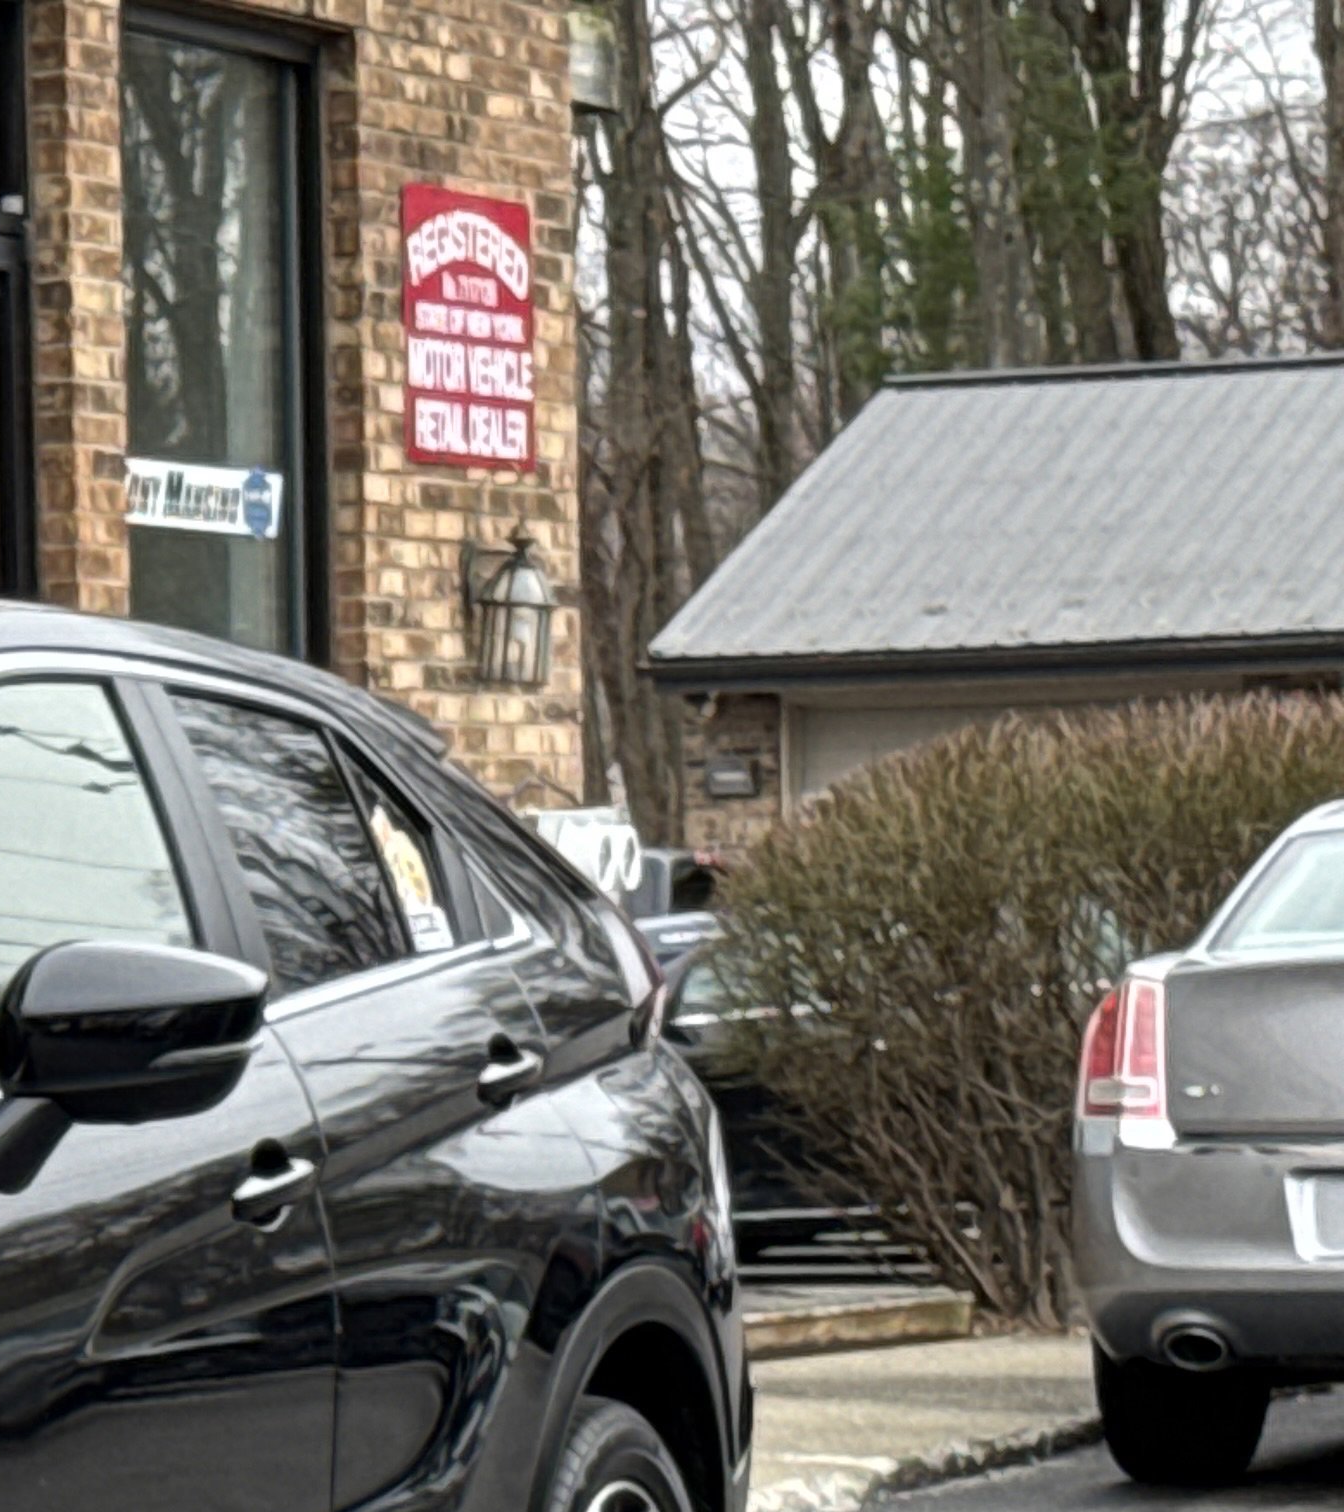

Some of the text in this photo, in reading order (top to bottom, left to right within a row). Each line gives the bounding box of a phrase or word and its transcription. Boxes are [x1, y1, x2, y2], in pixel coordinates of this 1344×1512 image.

[407, 209, 529, 301] REGISTERED
[408, 336, 535, 402] MOTOR VEHICLE
[415, 397, 529, 462] RETAIL DEALER
[127, 472, 162, 517] ONY
